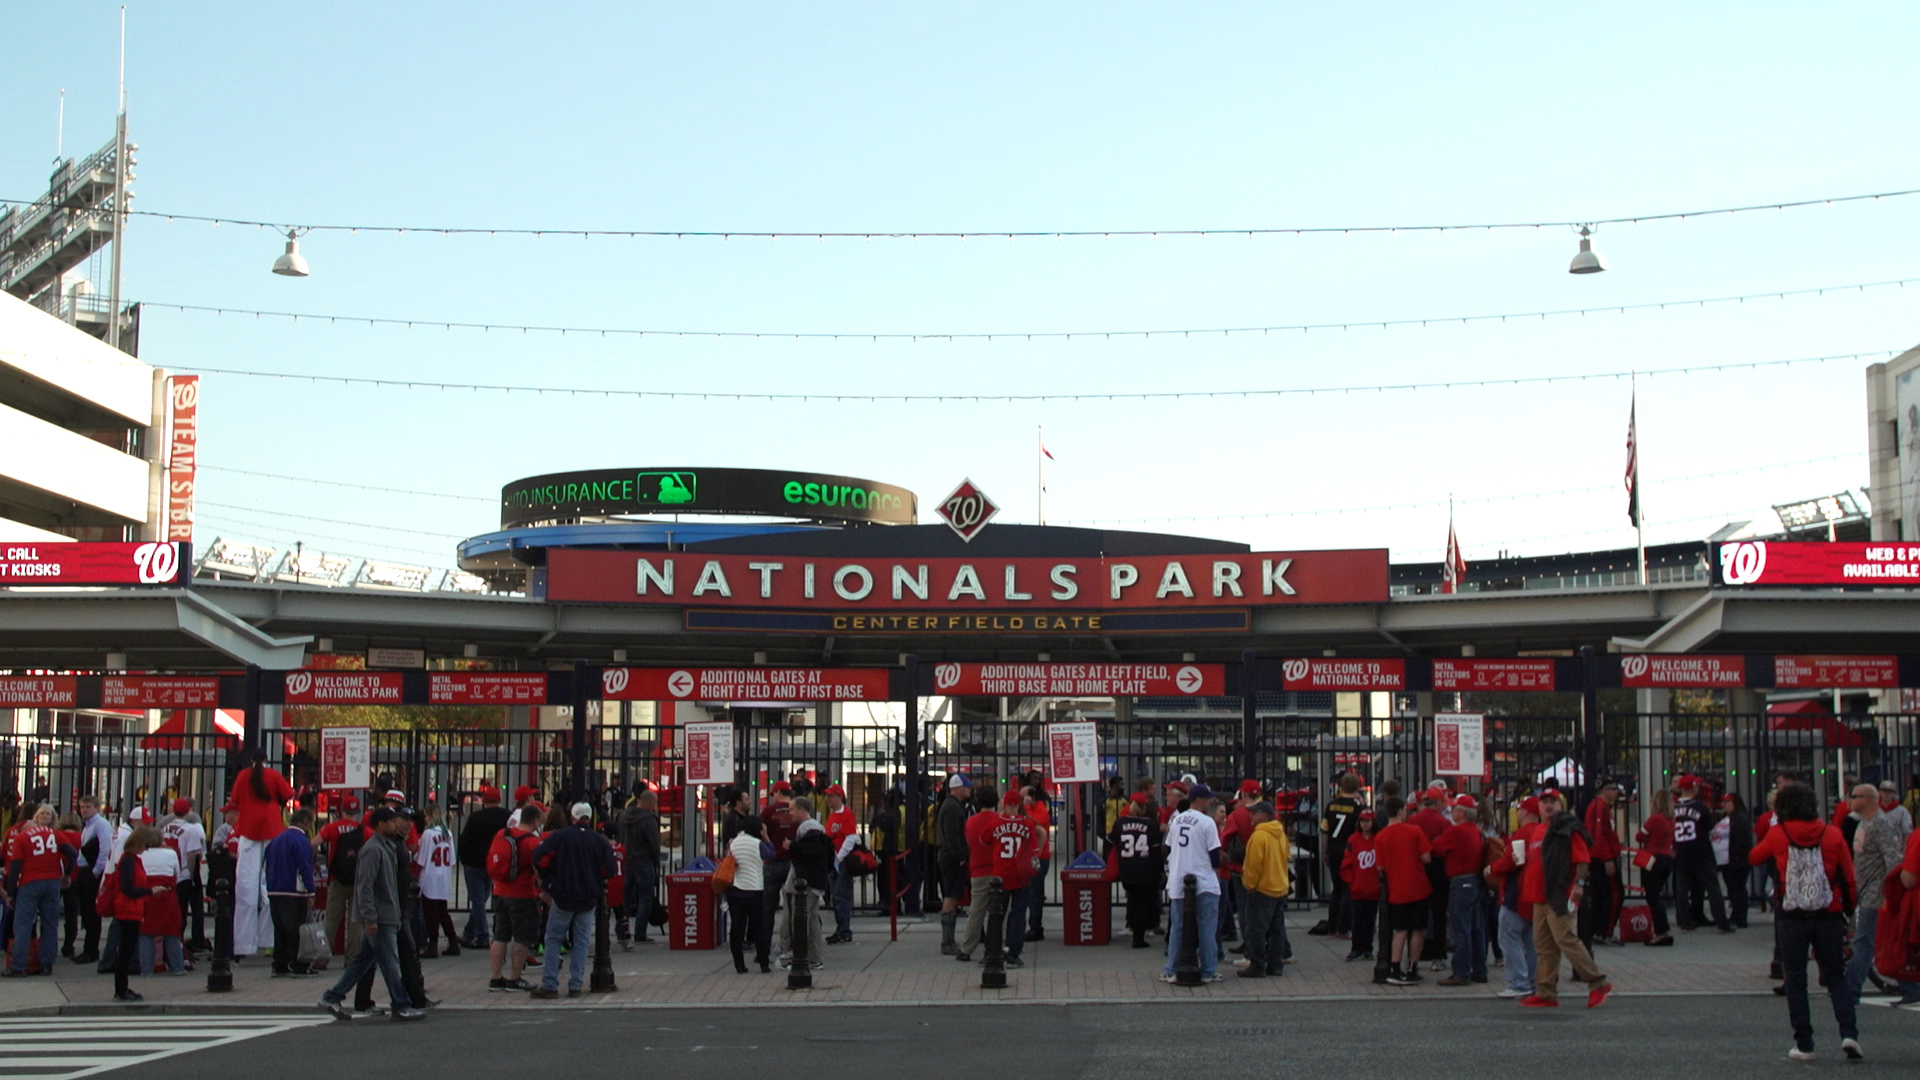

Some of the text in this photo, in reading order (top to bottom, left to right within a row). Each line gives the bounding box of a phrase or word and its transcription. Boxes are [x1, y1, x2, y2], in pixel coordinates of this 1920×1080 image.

[171, 415, 196, 473] TEAM
[532, 480, 633, 506] INSURANCE
[783, 481, 902, 511] esurance
[7, 548, 39, 560] CALL
[1865, 547, 1894, 560] WEB
[11, 563, 61, 576] KIOSKS
[1843, 564, 1919, 577] AVAILABLE
[637, 559, 1297, 601] NATIONALS PARK
[833, 616, 1101, 629] CENTER FIELD GATE
[1312, 663, 1380, 673] WELCOME TO
[1434, 662, 1454, 670] METAL
[1651, 660, 1720, 671] WELCOME TO
[700, 670, 822, 684] ADDITIONAL GATES AT
[981, 665, 1171, 681] ADDITIONAL GATES AT LEFT FIELD,
[1312, 674, 1400, 685] NATIONALS PARK
[1434, 670, 1470, 678] DETECTORS
[1651, 671, 1741, 682] NATIONALS PARK
[42, 681, 54, 691] TO
[314, 676, 380, 687] WELCOME TO
[432, 684, 466, 692] DETECTORS
[981, 679, 1147, 693] THIRD BASE AND HOME PLATE
[46, 692, 72, 702] PARK
[105, 688, 139, 696] DETECTORS
[314, 687, 399, 698] NATIONALS PARK
[700, 684, 864, 698] RIGHT FIELD AND FIRST BASE
[1332, 813, 1347, 838] 7
[1674, 820, 1697, 842] 23
[1178, 826, 1190, 847] 5
[30, 834, 58, 856] 34
[1120, 834, 1149, 858] 34
[431, 846, 451, 867] 40
[684, 894, 698, 947] TRASH
[1080, 890, 1093, 942] TRASH
